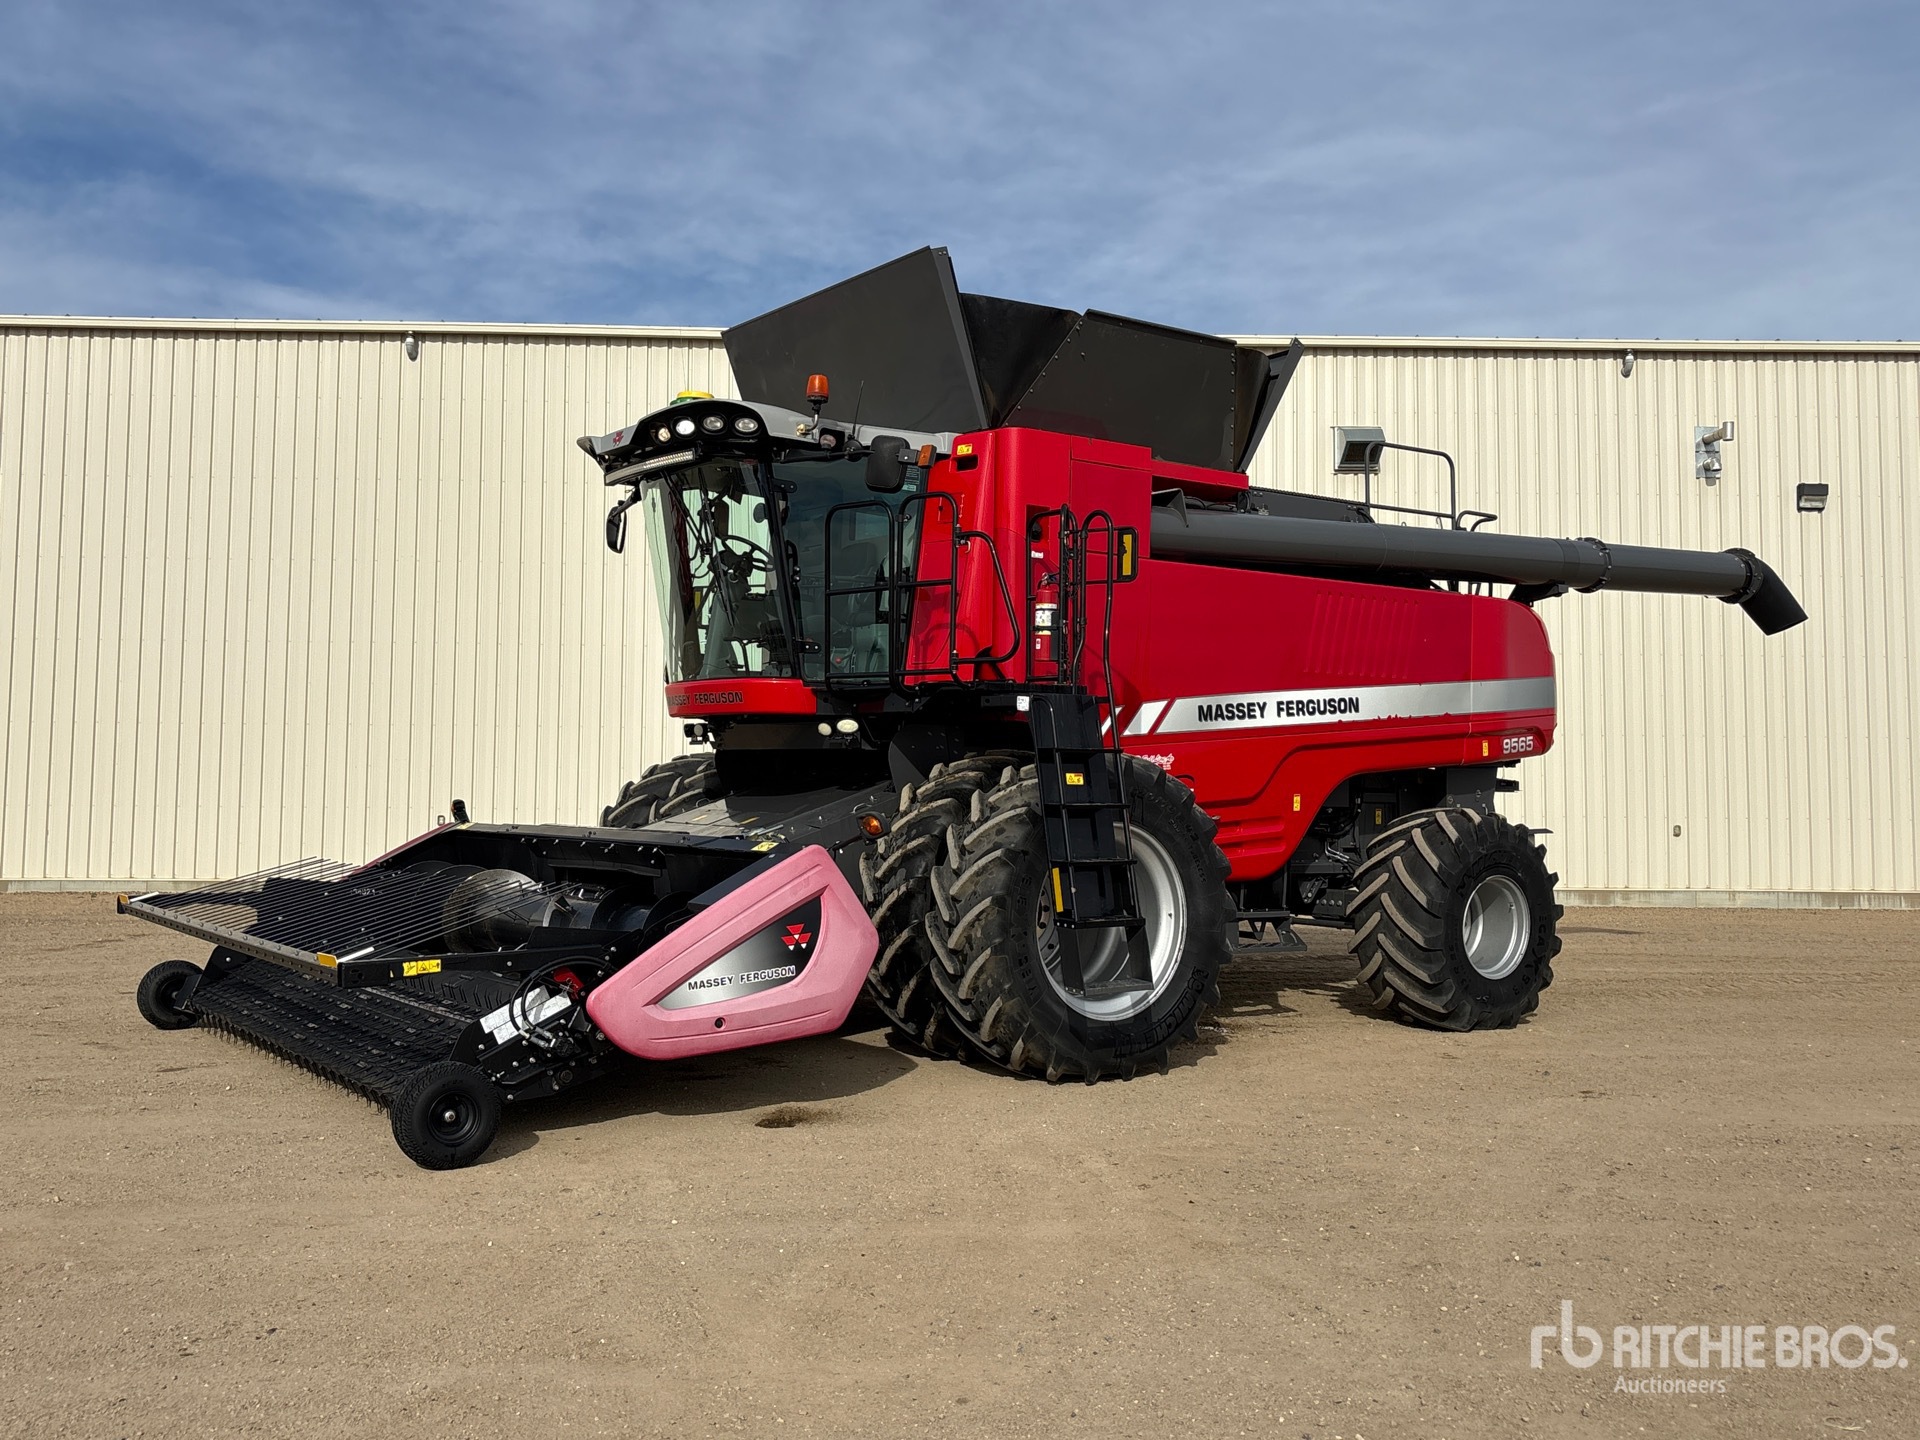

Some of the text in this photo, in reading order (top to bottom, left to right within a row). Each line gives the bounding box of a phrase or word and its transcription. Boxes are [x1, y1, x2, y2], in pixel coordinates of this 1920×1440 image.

[694, 691, 744, 704] FERGUSON
[1198, 697, 1359, 722] MASSEY FERGUSON
[1503, 736, 1533, 754] 9565
[688, 966, 796, 991] MASSEY FERGUSON
